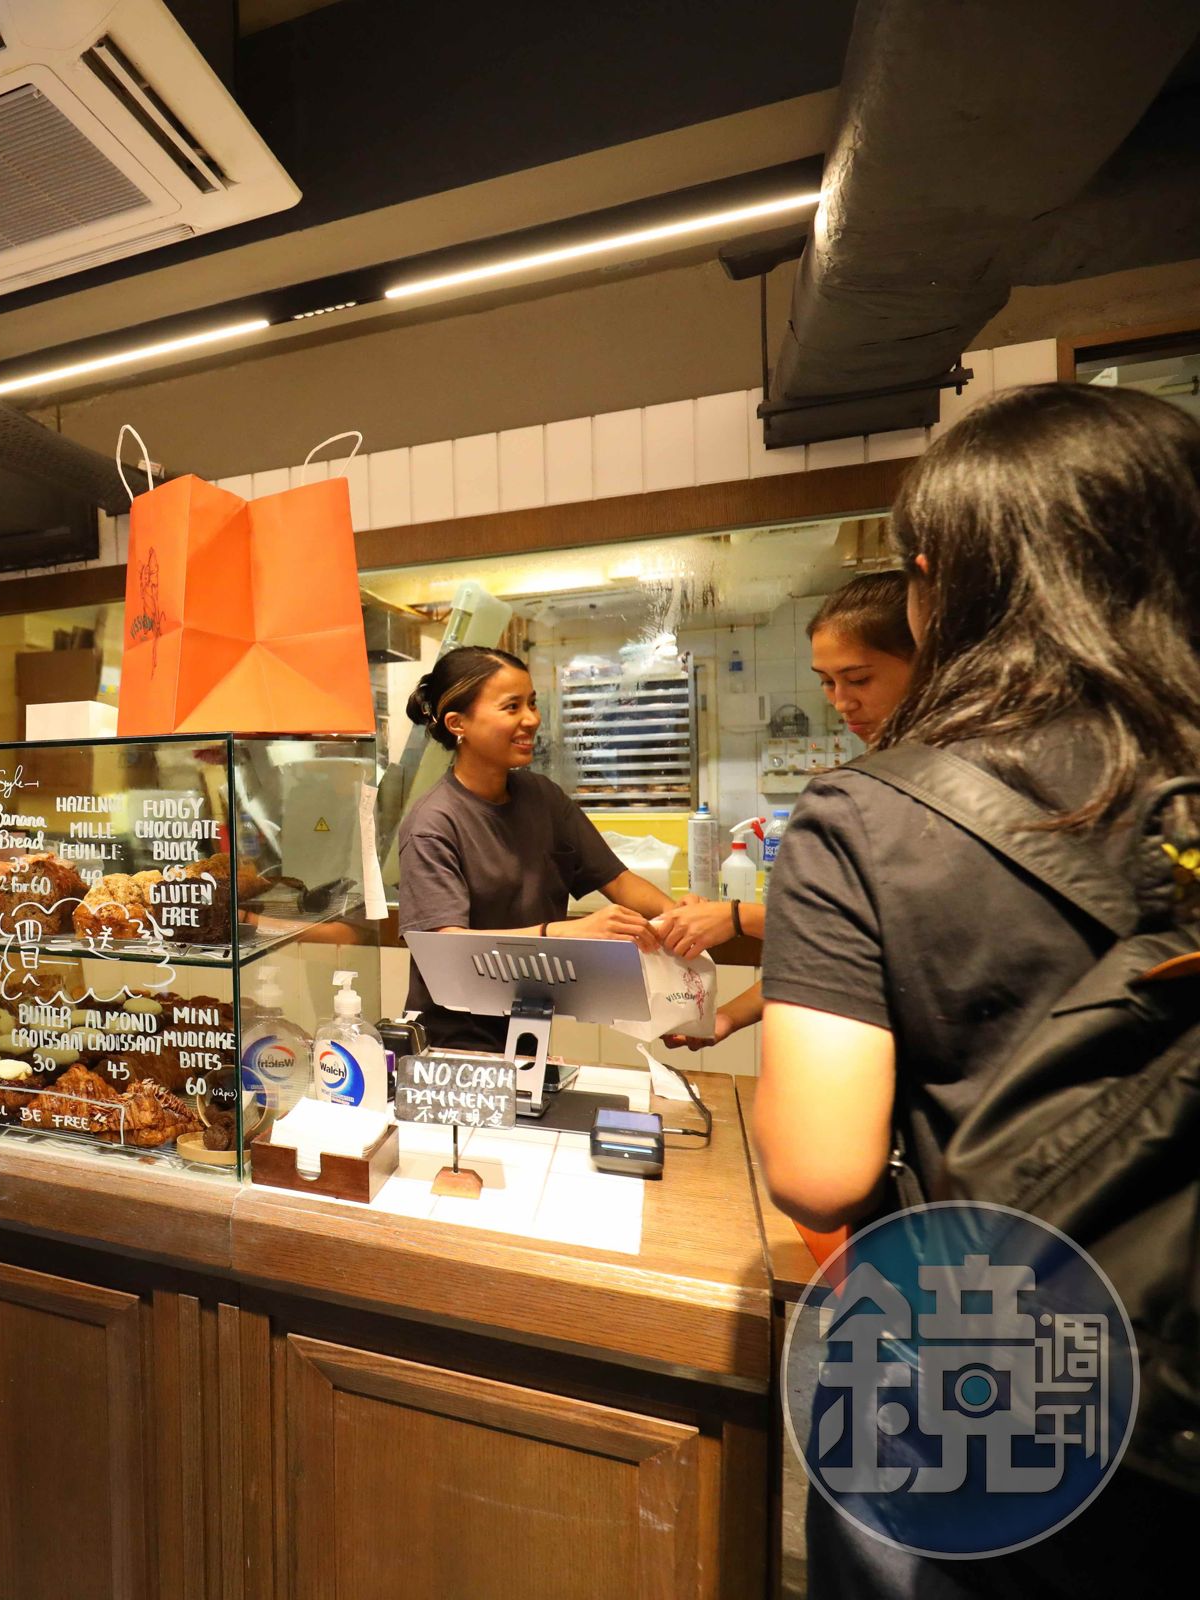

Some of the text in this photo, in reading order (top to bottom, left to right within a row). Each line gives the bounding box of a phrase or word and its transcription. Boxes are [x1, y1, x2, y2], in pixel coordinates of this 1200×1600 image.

[143, 798, 204, 819] FUDGY
[70, 822, 117, 839] MILLE
[135, 820, 222, 840] CHOCOLATE
[153, 840, 200, 862] BLOCK
[10, 857, 29, 873] 35
[163, 864, 187, 883] 65
[0, 875, 9, 890] 2
[31, 876, 51, 896] 60
[150, 883, 213, 906] GLUTEN
[162, 906, 200, 927] FREE
[18, 1003, 71, 1029] BUTTER
[85, 1010, 157, 1033] ALMOND
[173, 1007, 219, 1026] MINI
[11, 1028, 84, 1051] CROISSANT
[87, 1034, 163, 1055] CROISSANT
[163, 1031, 236, 1050] MUDCAKE
[33, 1054, 56, 1072] 30
[107, 1060, 130, 1080] 45
[180, 1051, 222, 1071] BITES
[320, 1062, 345, 1078] Walch
[413, 1061, 514, 1090] NO CASH
[185, 1077, 206, 1096] 60
[400, 1087, 509, 1112] PAYMENT
[19, 1106, 42, 1122] BE
[52, 1114, 90, 1131] FREE
